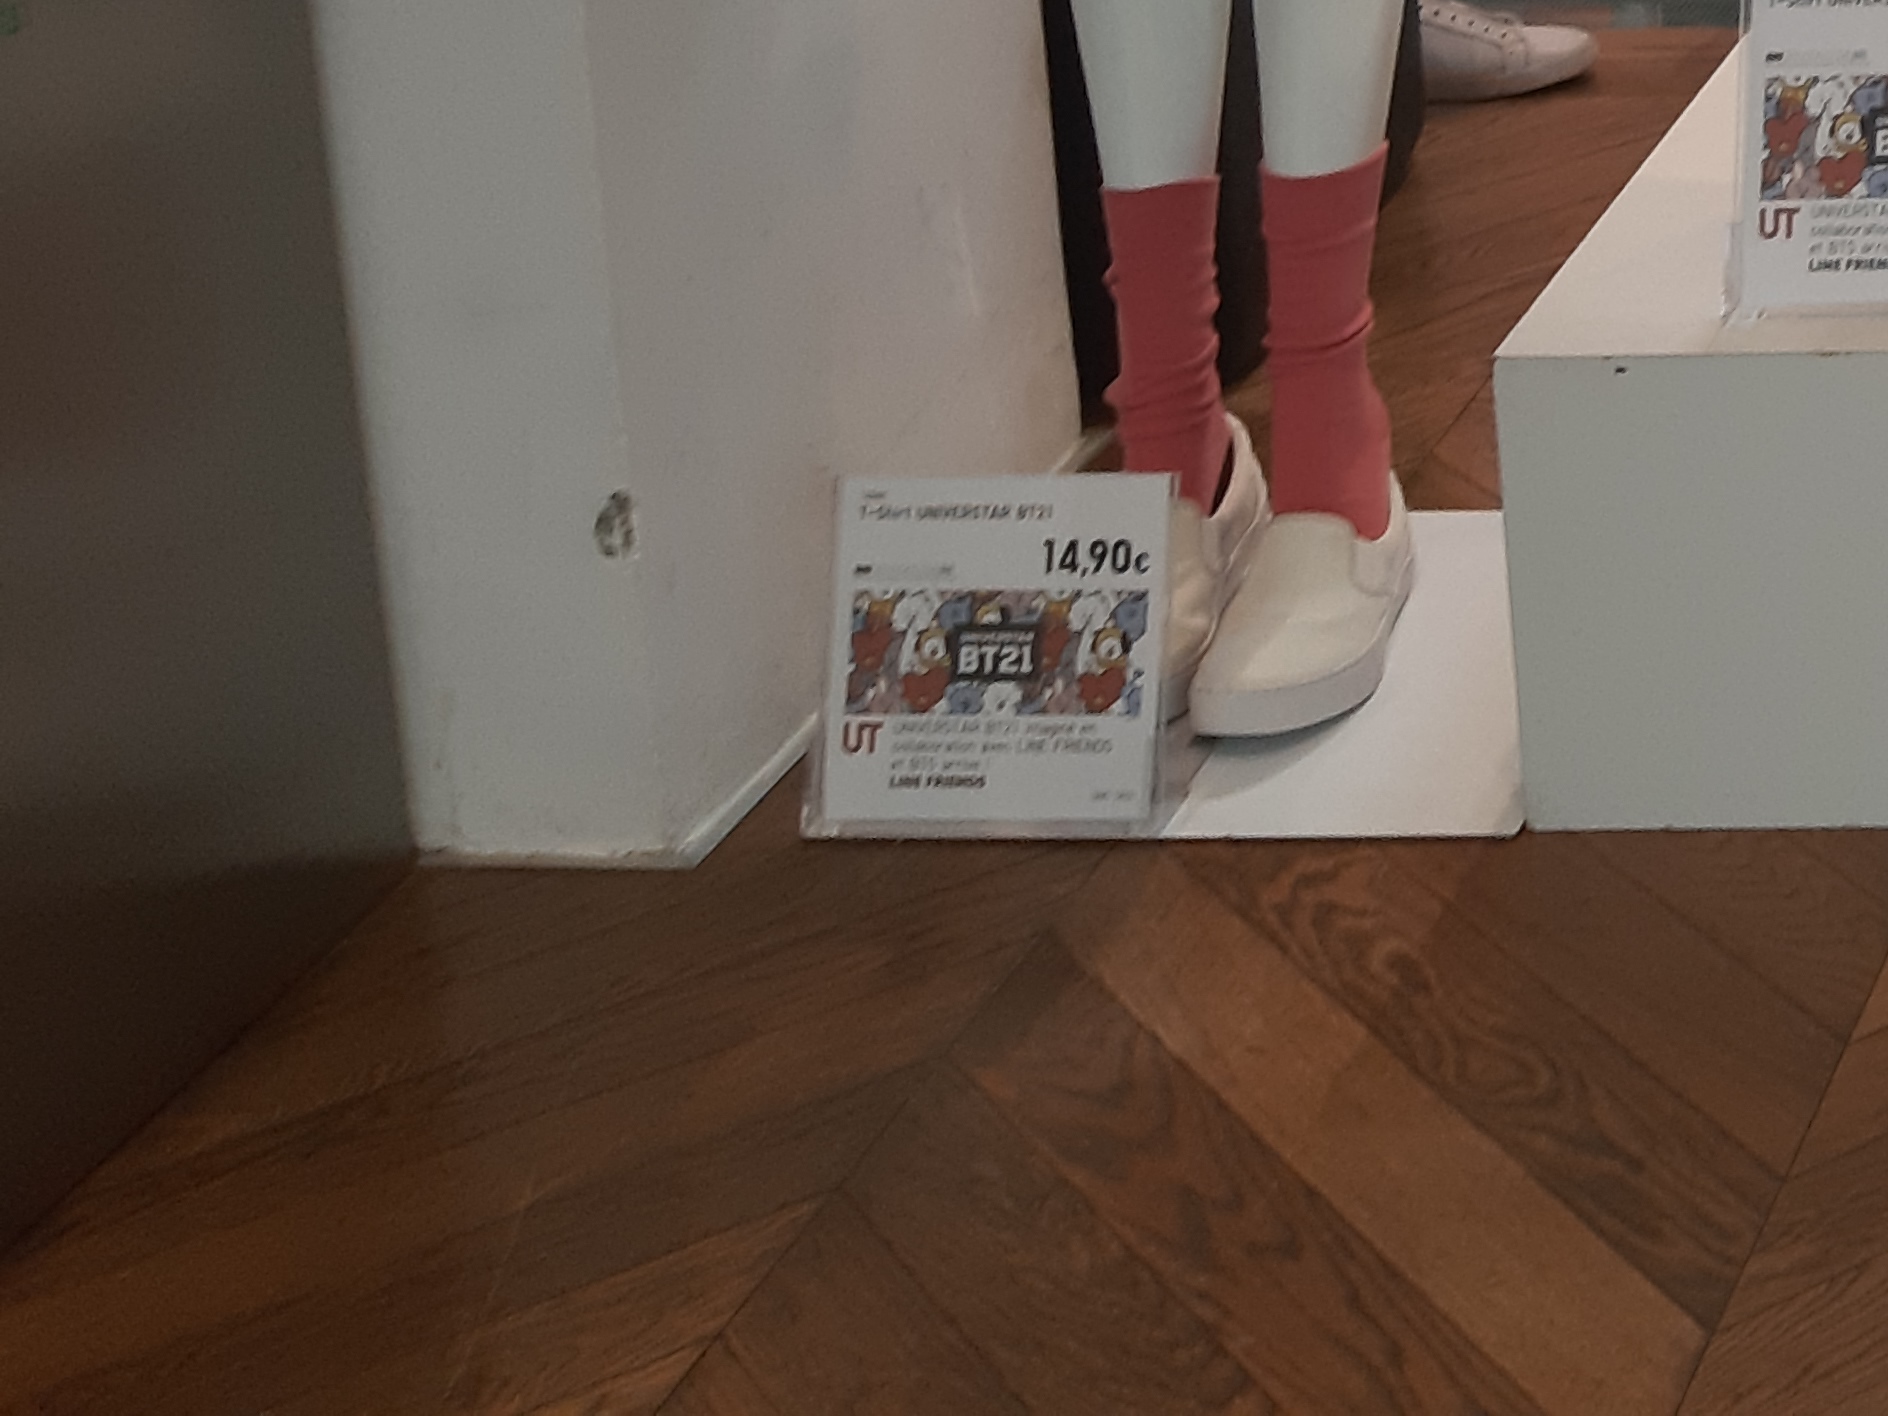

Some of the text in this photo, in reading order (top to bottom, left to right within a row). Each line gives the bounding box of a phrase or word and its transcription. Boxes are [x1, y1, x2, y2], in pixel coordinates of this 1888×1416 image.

[1758, 207, 1800, 240] UT
[957, 644, 1034, 675] BT21
[841, 720, 884, 754] UT
